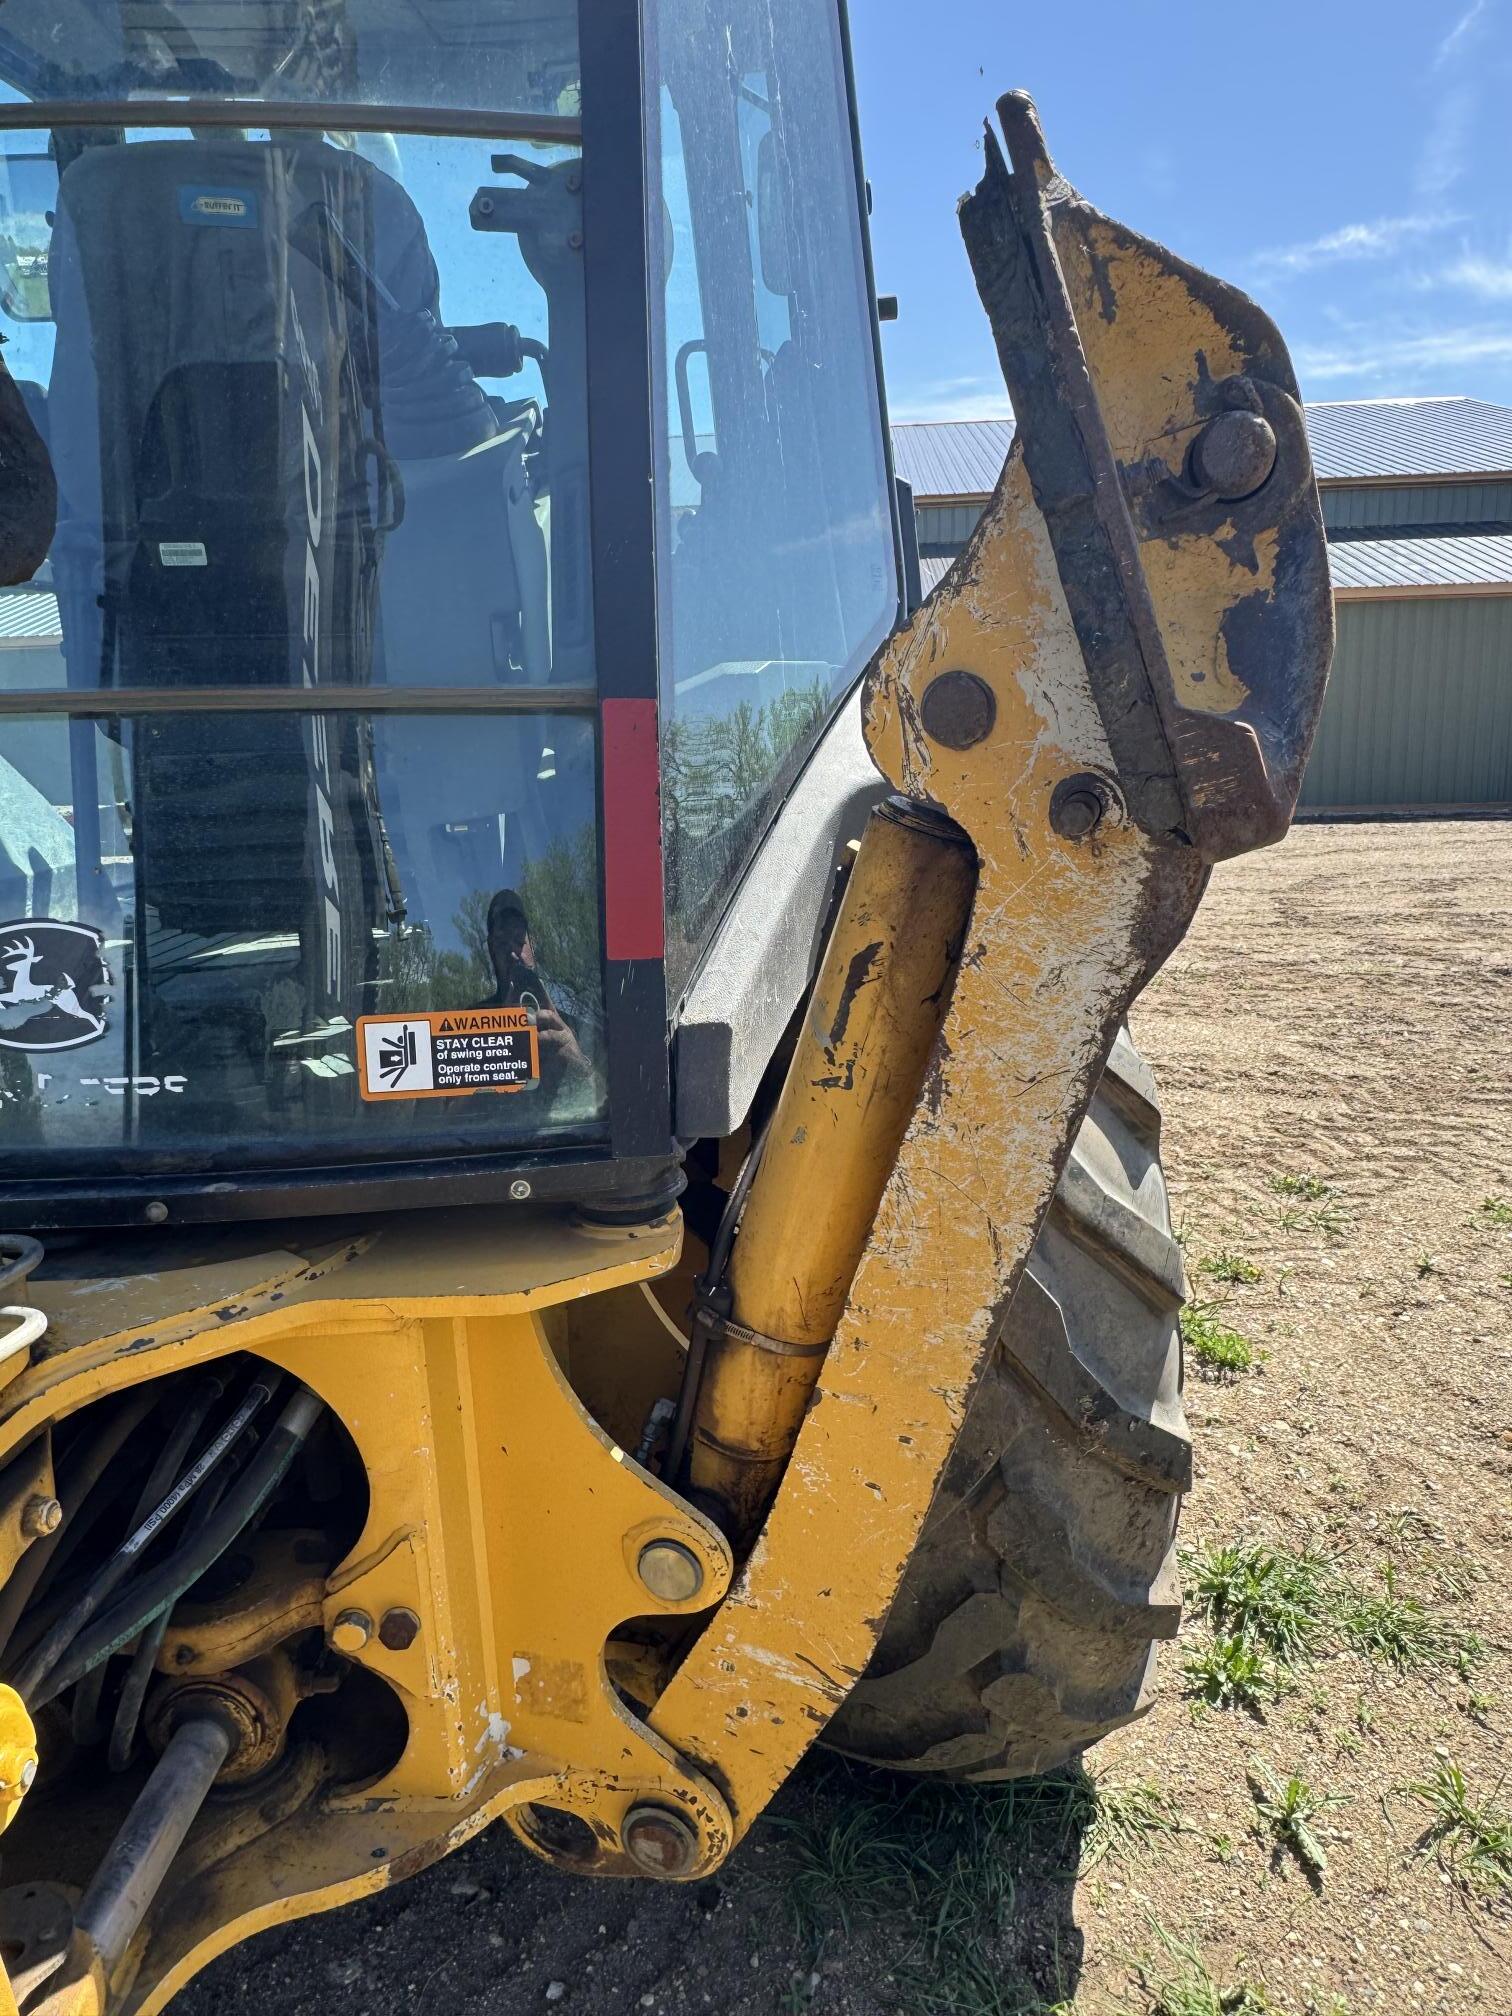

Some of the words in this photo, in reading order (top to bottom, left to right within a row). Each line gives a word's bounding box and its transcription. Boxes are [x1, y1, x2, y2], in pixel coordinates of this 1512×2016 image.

[454, 1014, 528, 1030] WARNING
[436, 1038, 468, 1049] STAY
[472, 1036, 513, 1048] CLEAR
[437, 1050, 448, 1060] of
[451, 1049, 483, 1060] swing
[486, 1048, 512, 1057] area.
[438, 1063, 480, 1075] Operate
[483, 1060, 527, 1071] controls
[439, 1073, 461, 1085] only
[464, 1073, 490, 1082] from
[493, 1071, 518, 1080] seat.
